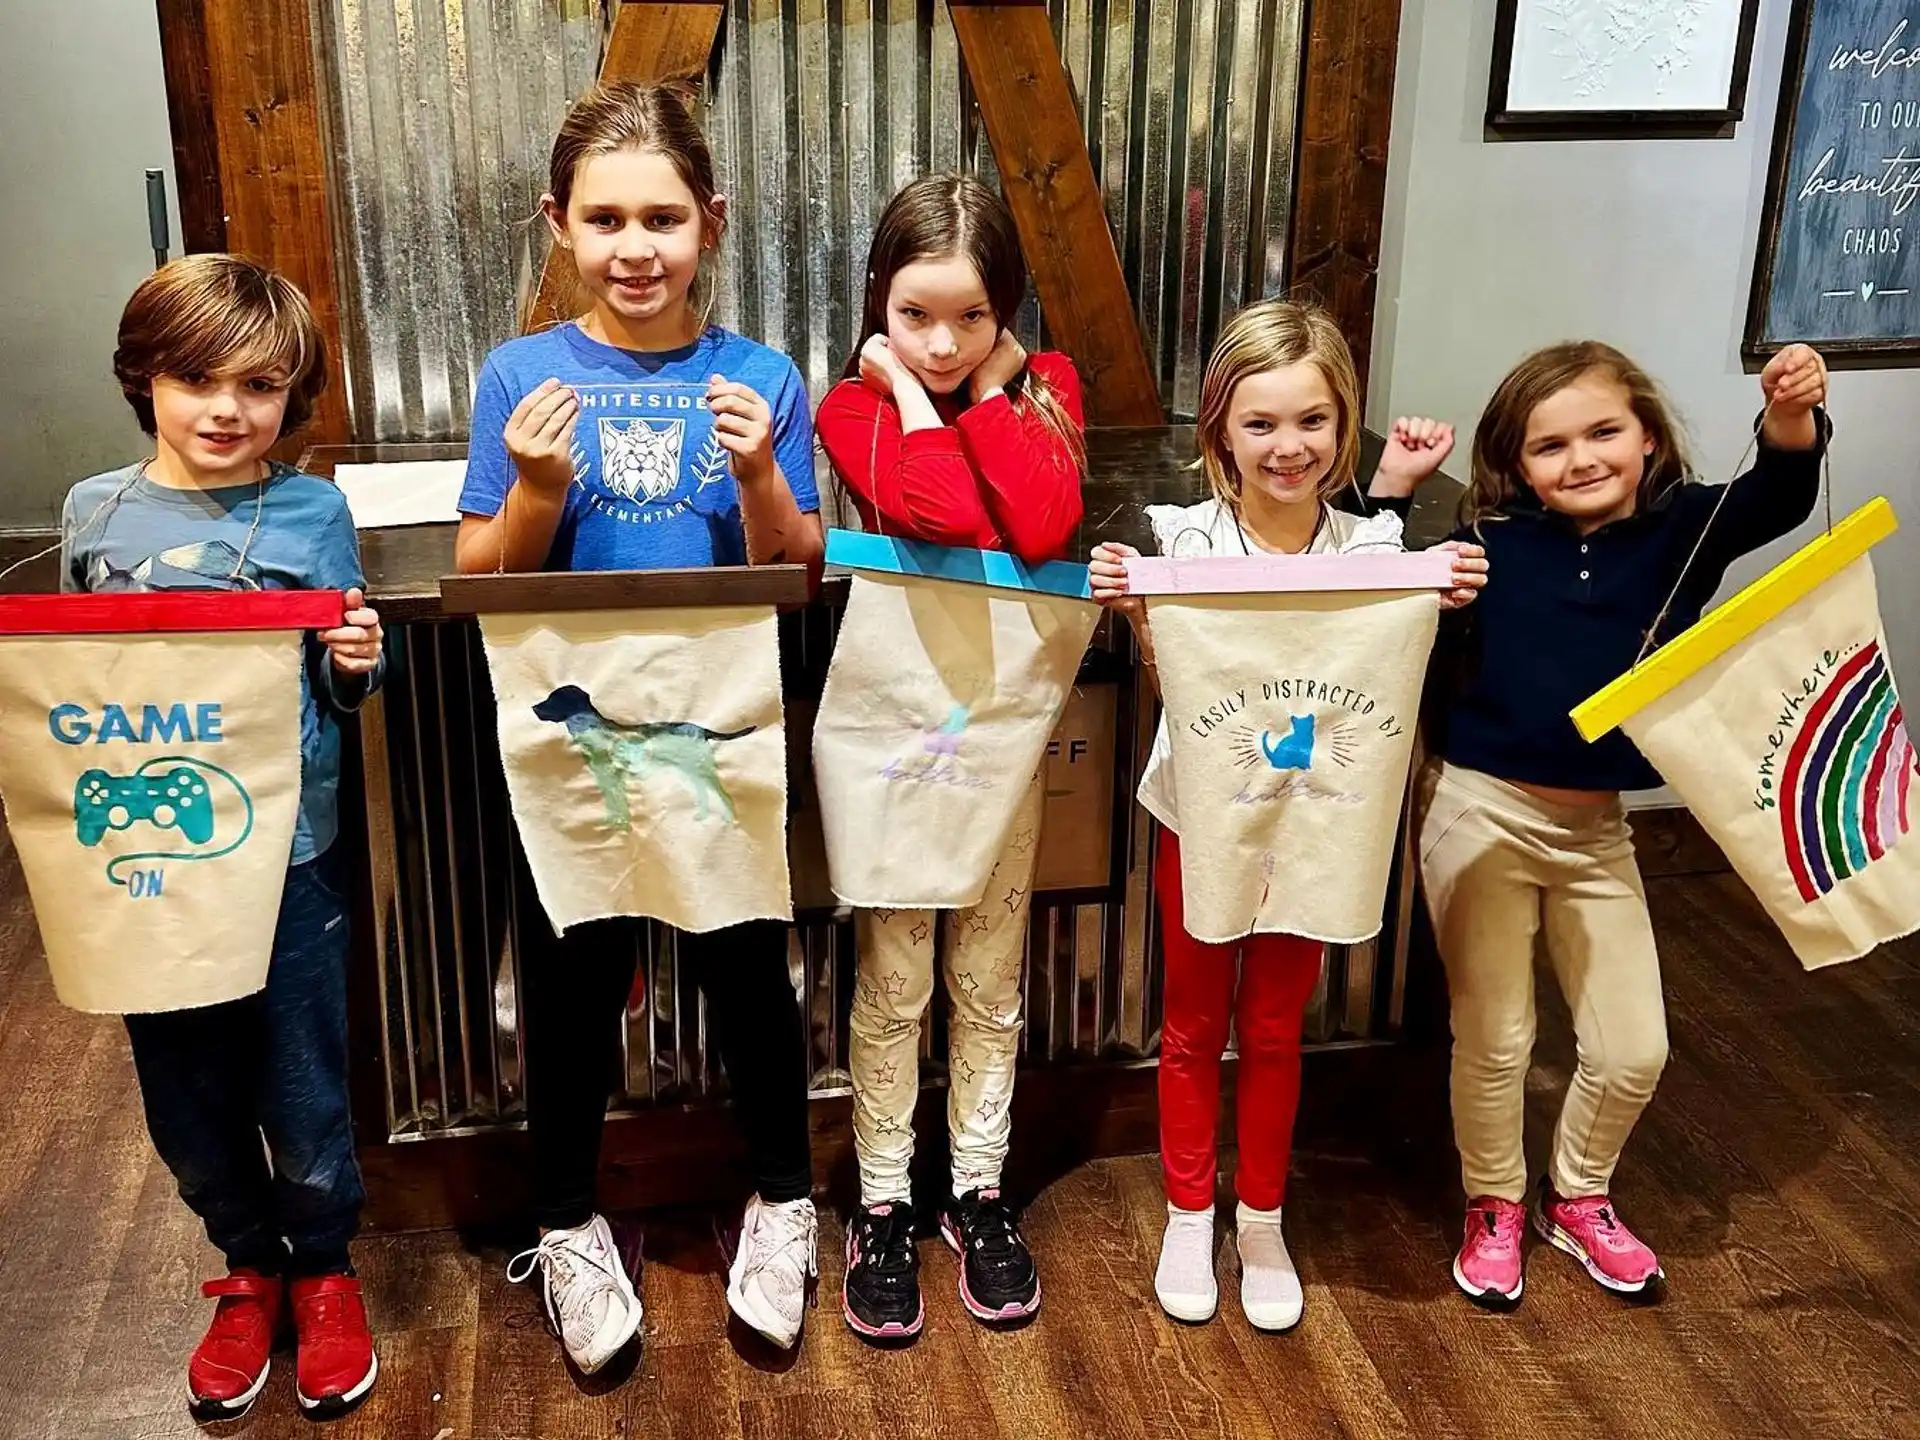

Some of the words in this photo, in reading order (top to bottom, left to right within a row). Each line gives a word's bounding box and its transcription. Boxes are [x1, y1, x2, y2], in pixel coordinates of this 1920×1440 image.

[1860, 101, 1881, 129] TO
[1843, 228, 1902, 255] CHAOS
[582, 393, 708, 410] HITESIDE
[590, 494, 694, 524] ELEMENTARY
[48, 702, 223, 745] GAME
[1189, 689, 1246, 739] EASILY
[1262, 678, 1375, 715] DISTRACTED
[1378, 715, 1404, 739] BY
[128, 868, 164, 898] ON
